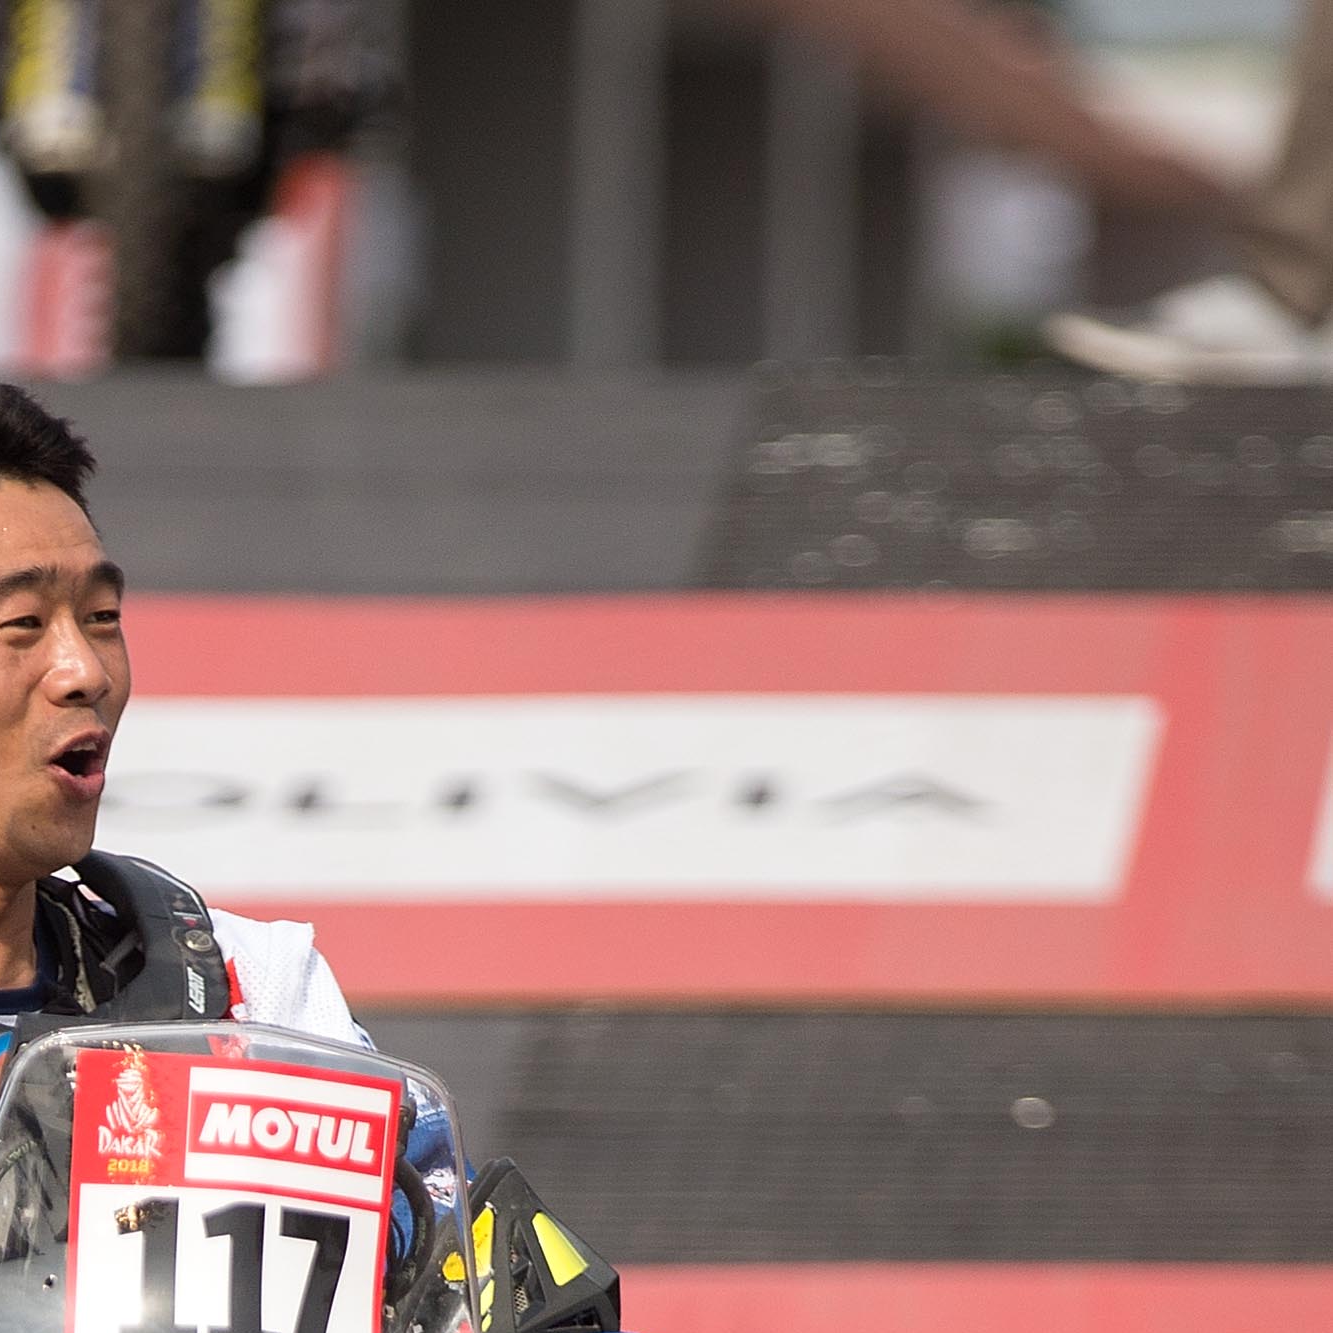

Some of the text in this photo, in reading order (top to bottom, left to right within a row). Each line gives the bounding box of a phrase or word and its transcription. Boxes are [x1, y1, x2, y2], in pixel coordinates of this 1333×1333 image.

[97, 1125, 163, 1156] DAKAR
[198, 1103, 377, 1164] MOTUL
[107, 1158, 150, 1173] 2018
